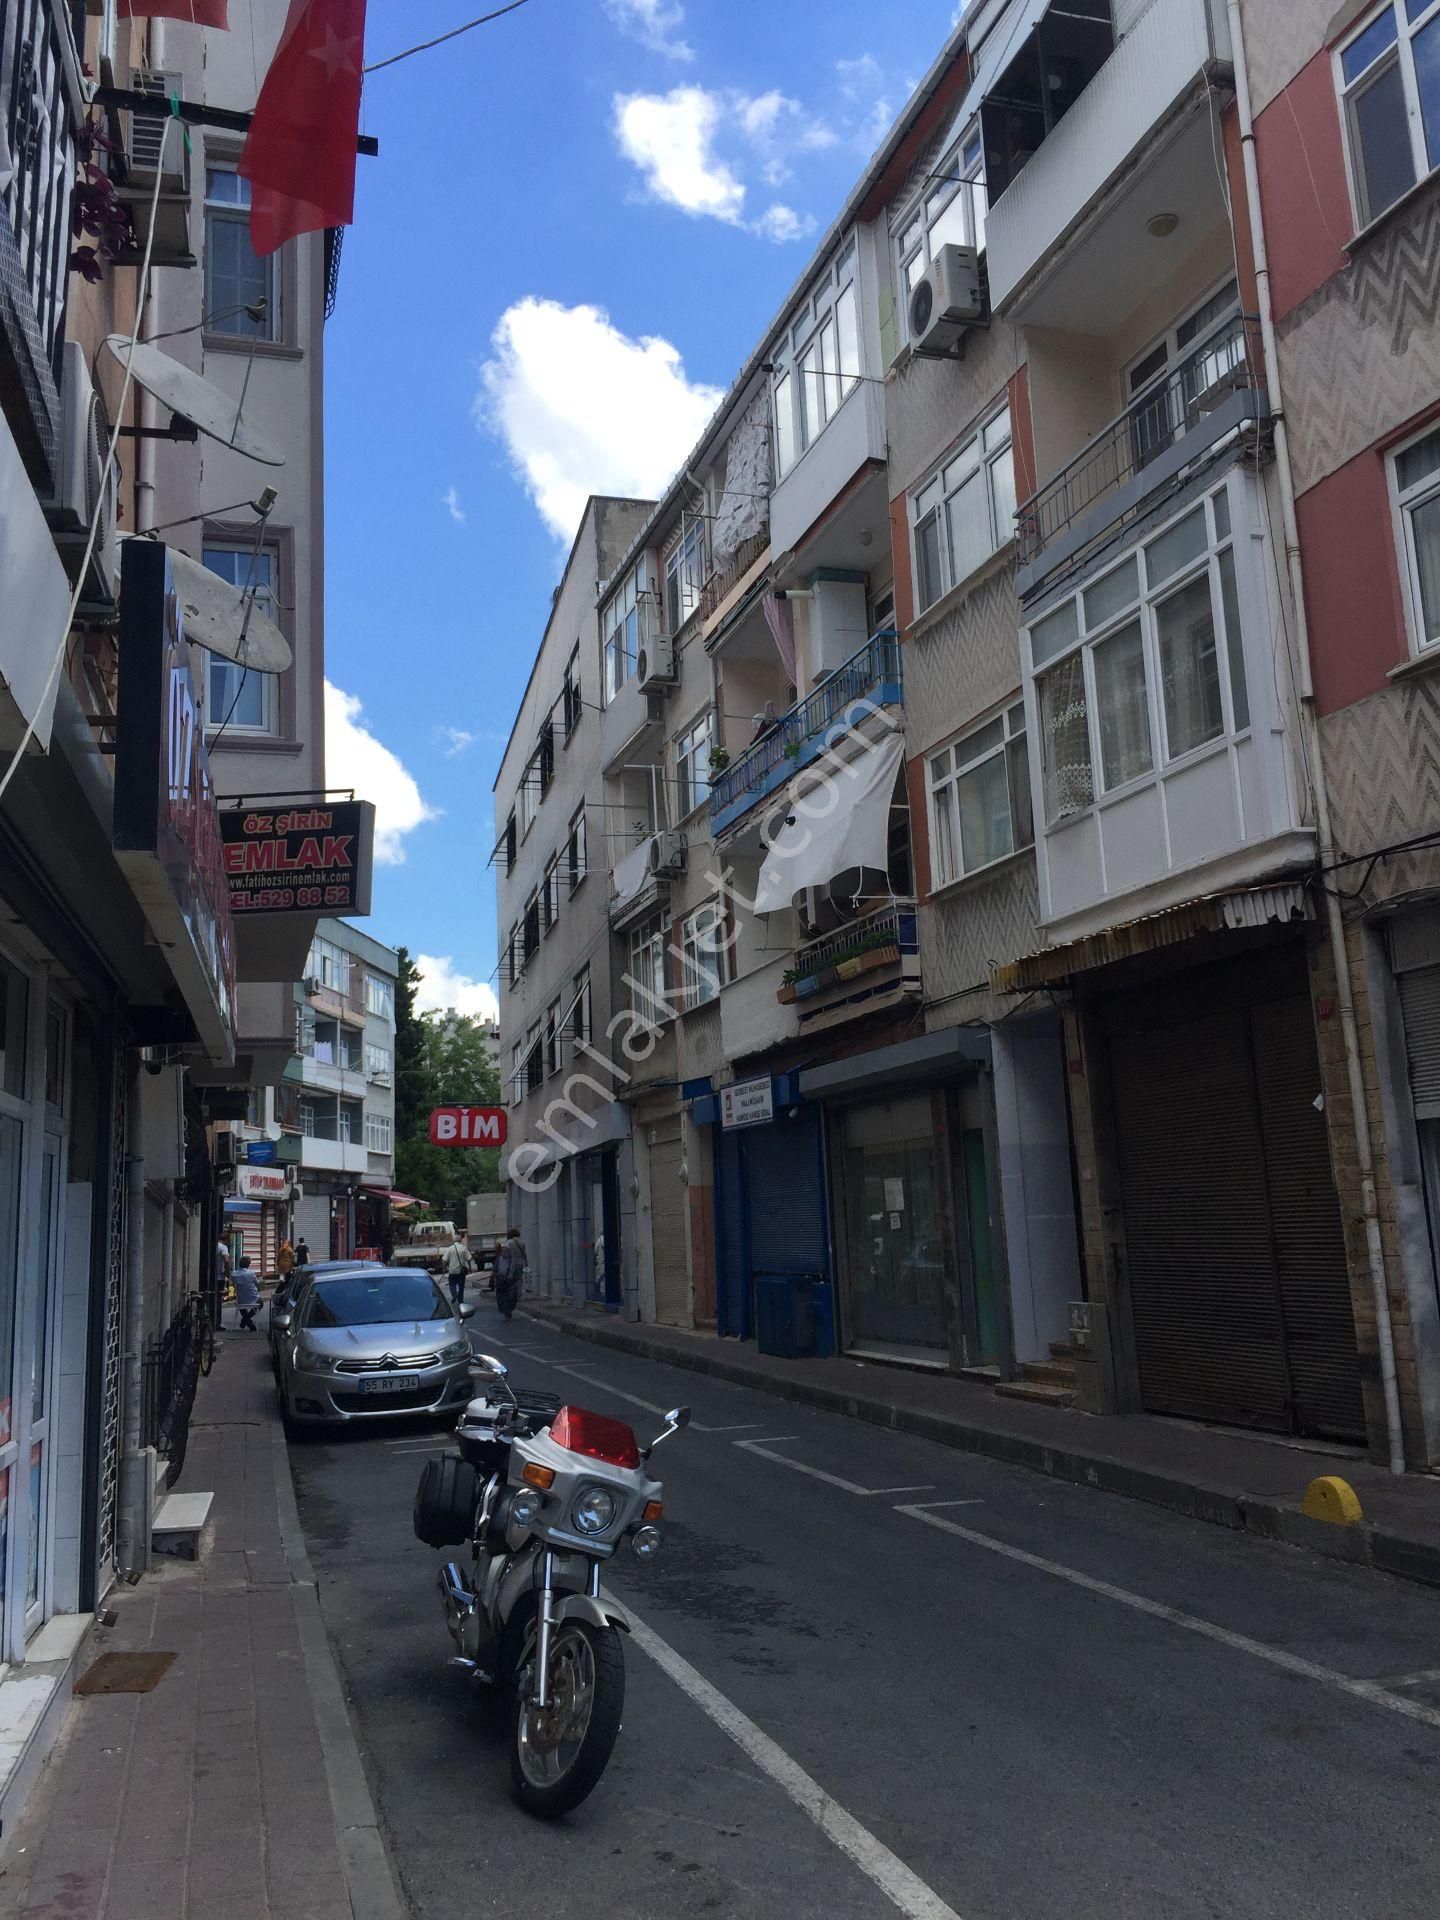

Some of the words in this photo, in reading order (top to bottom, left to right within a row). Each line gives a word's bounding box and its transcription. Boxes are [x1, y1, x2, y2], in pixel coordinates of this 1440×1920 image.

[243, 813, 273, 834] ÖZ
[276, 810, 333, 835] ŞİRİN
[223, 835, 354, 873] EMLAK
[297, 887, 321, 906] 88
[324, 885, 350, 904] 52
[437, 1108, 500, 1140] BİM
[365, 1381, 378, 1390] 55
[382, 1380, 394, 1389] RY
[399, 1378, 417, 1388] 234
